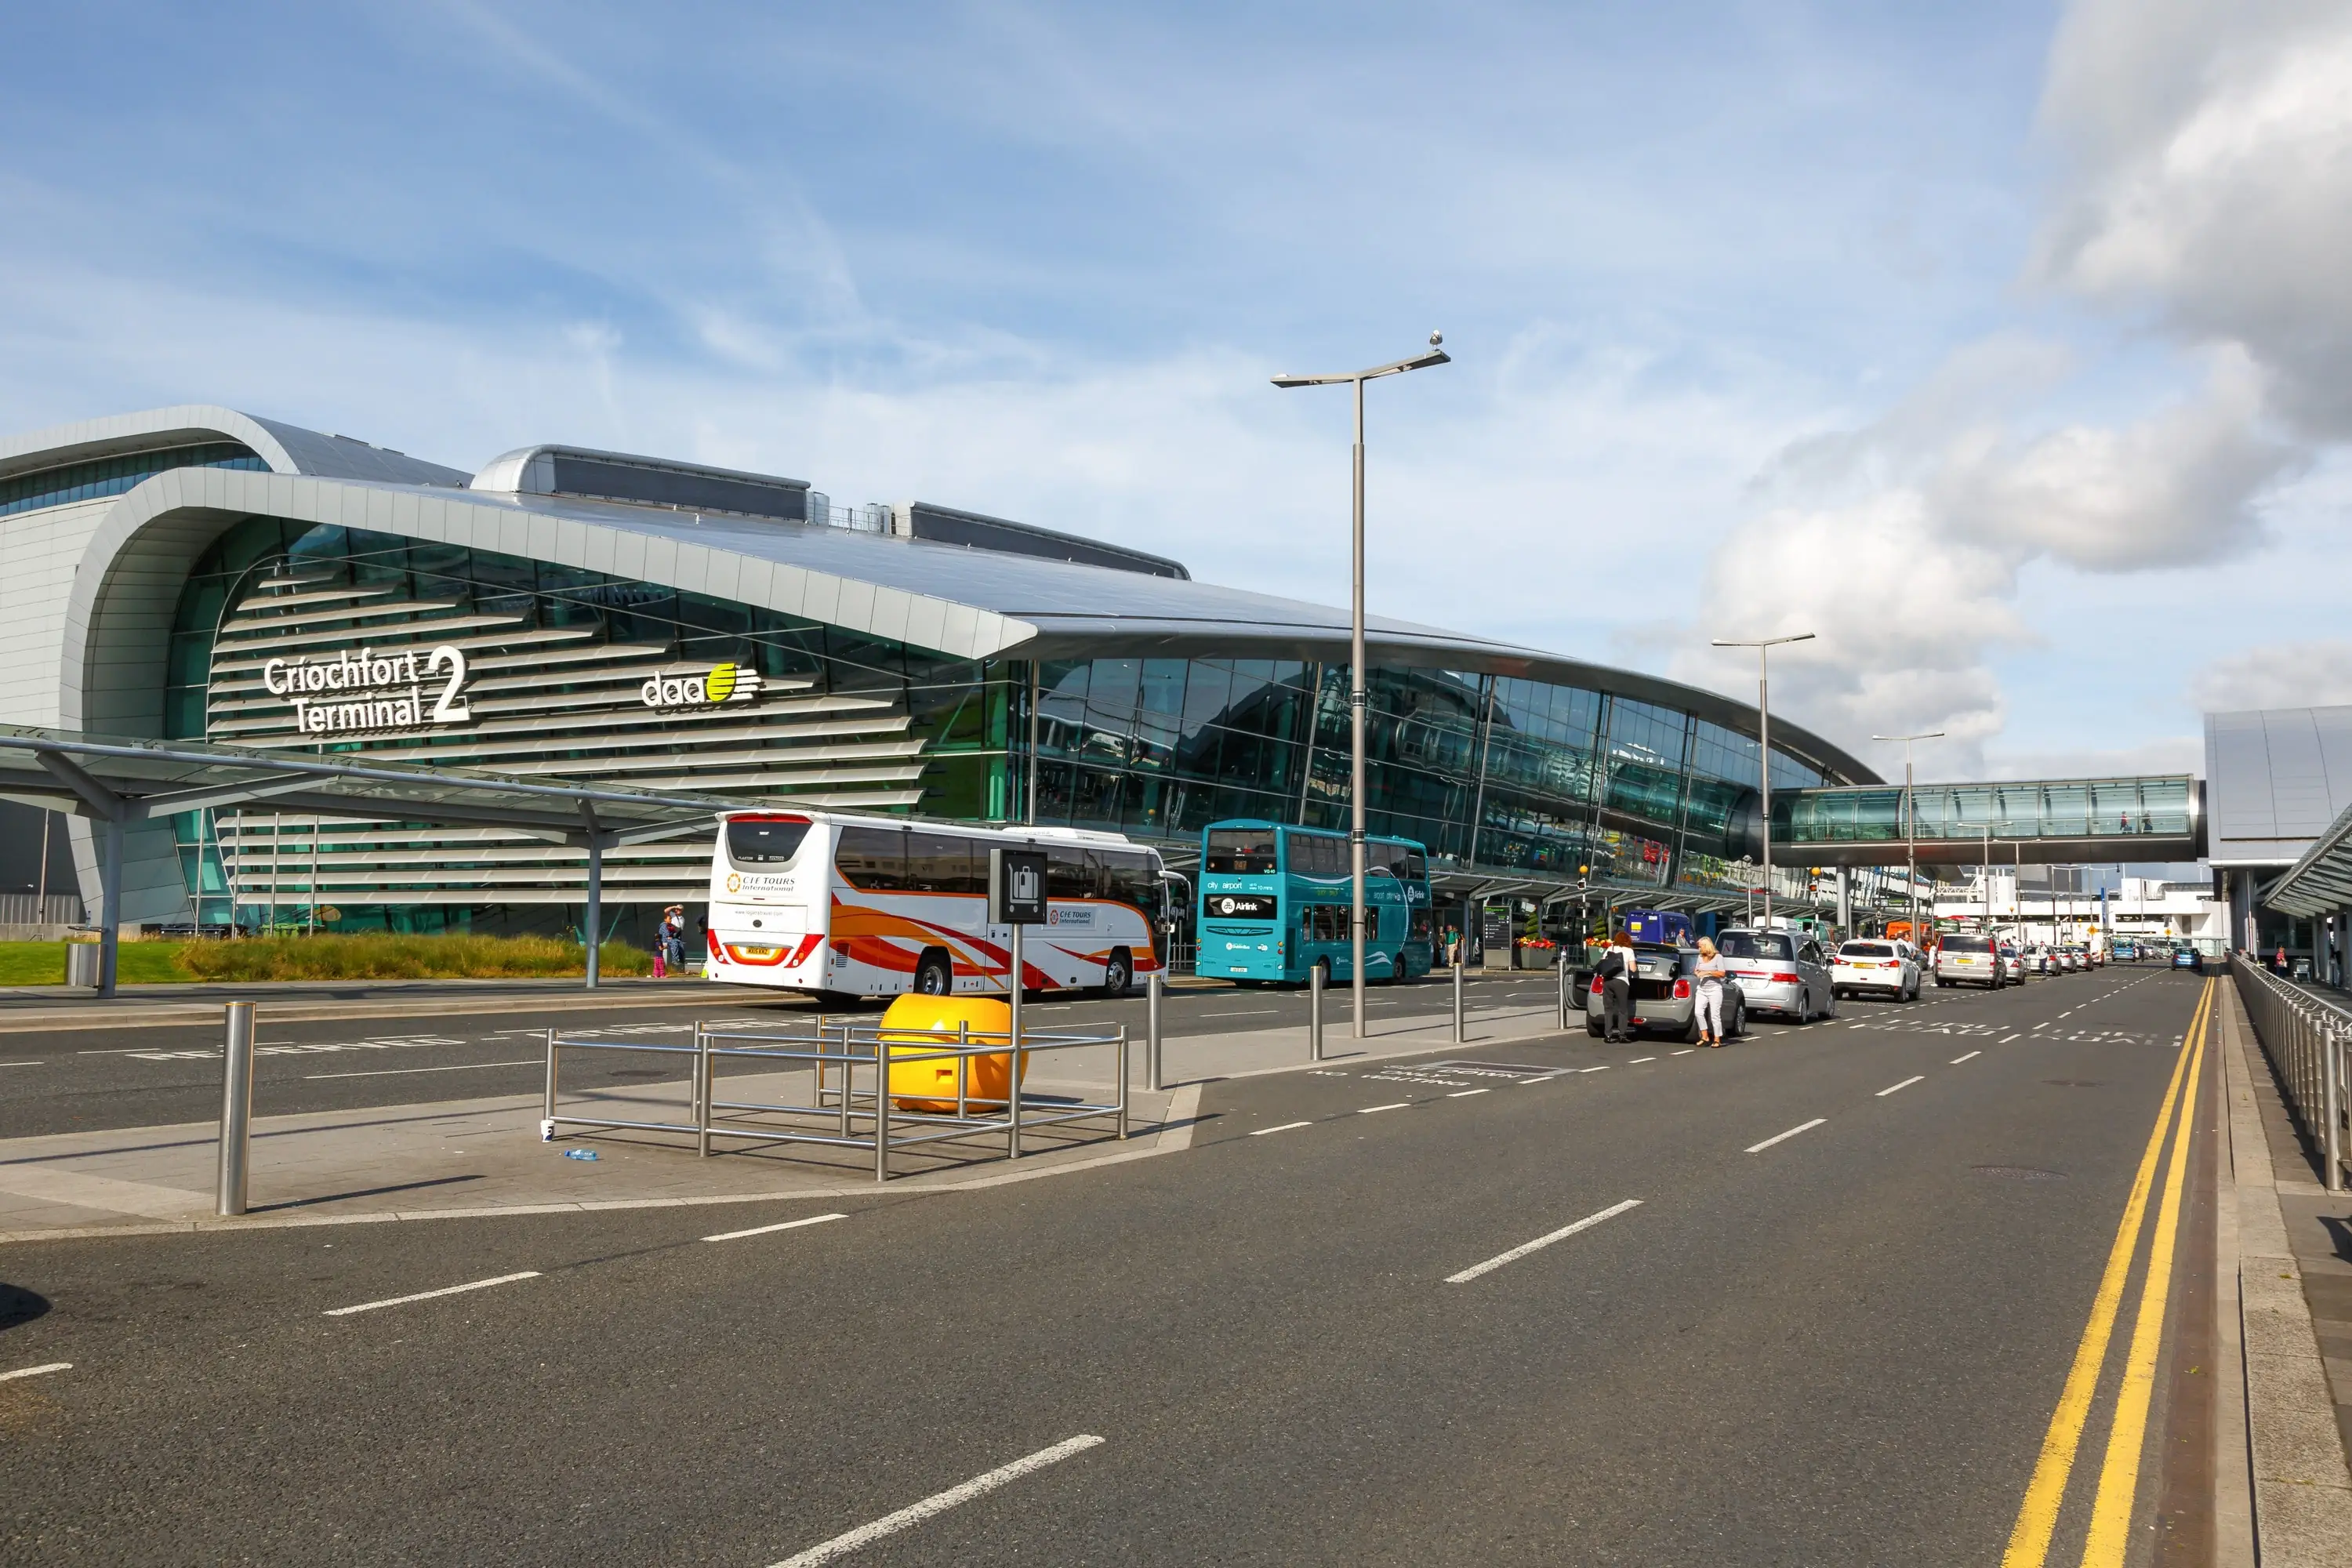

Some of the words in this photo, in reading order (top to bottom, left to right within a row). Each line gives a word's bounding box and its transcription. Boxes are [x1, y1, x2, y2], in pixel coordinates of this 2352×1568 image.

[264, 647, 420, 695] Críochfort
[290, 685, 423, 732] Terminal
[428, 644, 470, 723] 2
[641, 670, 706, 706] daa
[763, 877, 796, 885] TOURS
[1207, 880, 1218, 891] city
[1221, 880, 1243, 891] airport
[1235, 902, 1258, 910] Airlink
[1849, 1023, 1997, 1036] ROAD
[1437, 1069, 1521, 1078] DOWN
[1360, 1074, 1471, 1087] WAITING
